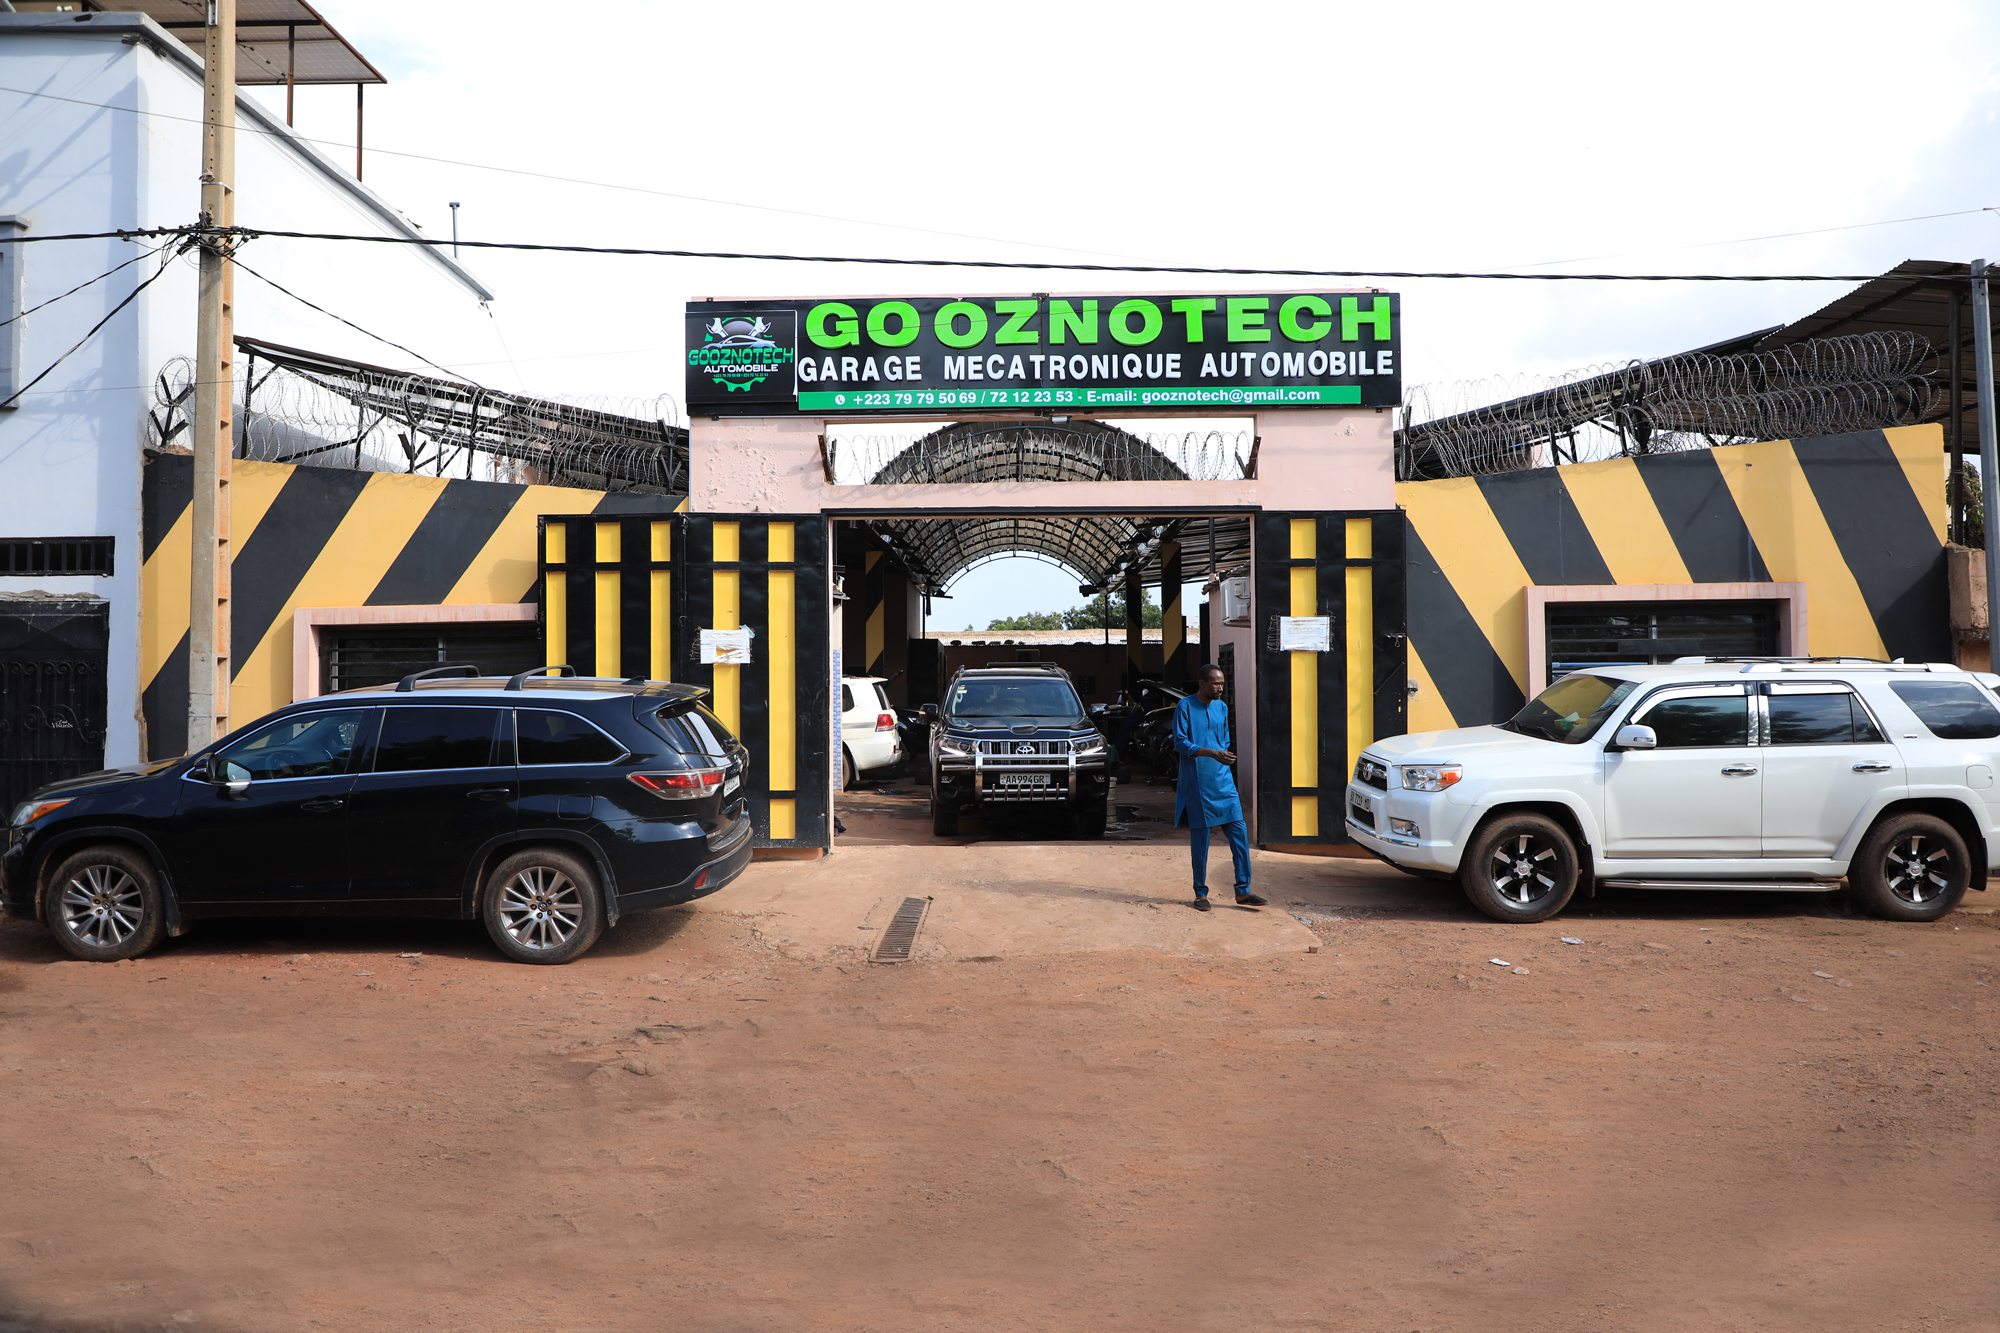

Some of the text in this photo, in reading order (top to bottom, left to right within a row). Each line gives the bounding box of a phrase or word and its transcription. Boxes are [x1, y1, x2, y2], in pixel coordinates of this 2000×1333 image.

[688, 347, 794, 365] GOOZNOTECH
[703, 364, 779, 373] AUTOMOBILE
[798, 350, 1394, 382] GARAGE MECATRONIQUE AUTOMOBILE
[854, 393, 891, 405] +223
[895, 393, 913, 405] 79
[917, 393, 935, 404] 79
[981, 391, 986, 404] /
[990, 391, 1008, 403] 72
[1013, 391, 1030, 403] 12
[1034, 391, 1052, 403] 23
[1056, 390, 1074, 403] 53
[1087, 389, 1138, 402] E-mail:
[1142, 388, 1321, 404] gooznotech@gmail.com
[1005, 775, 1045, 784] AA994GR
